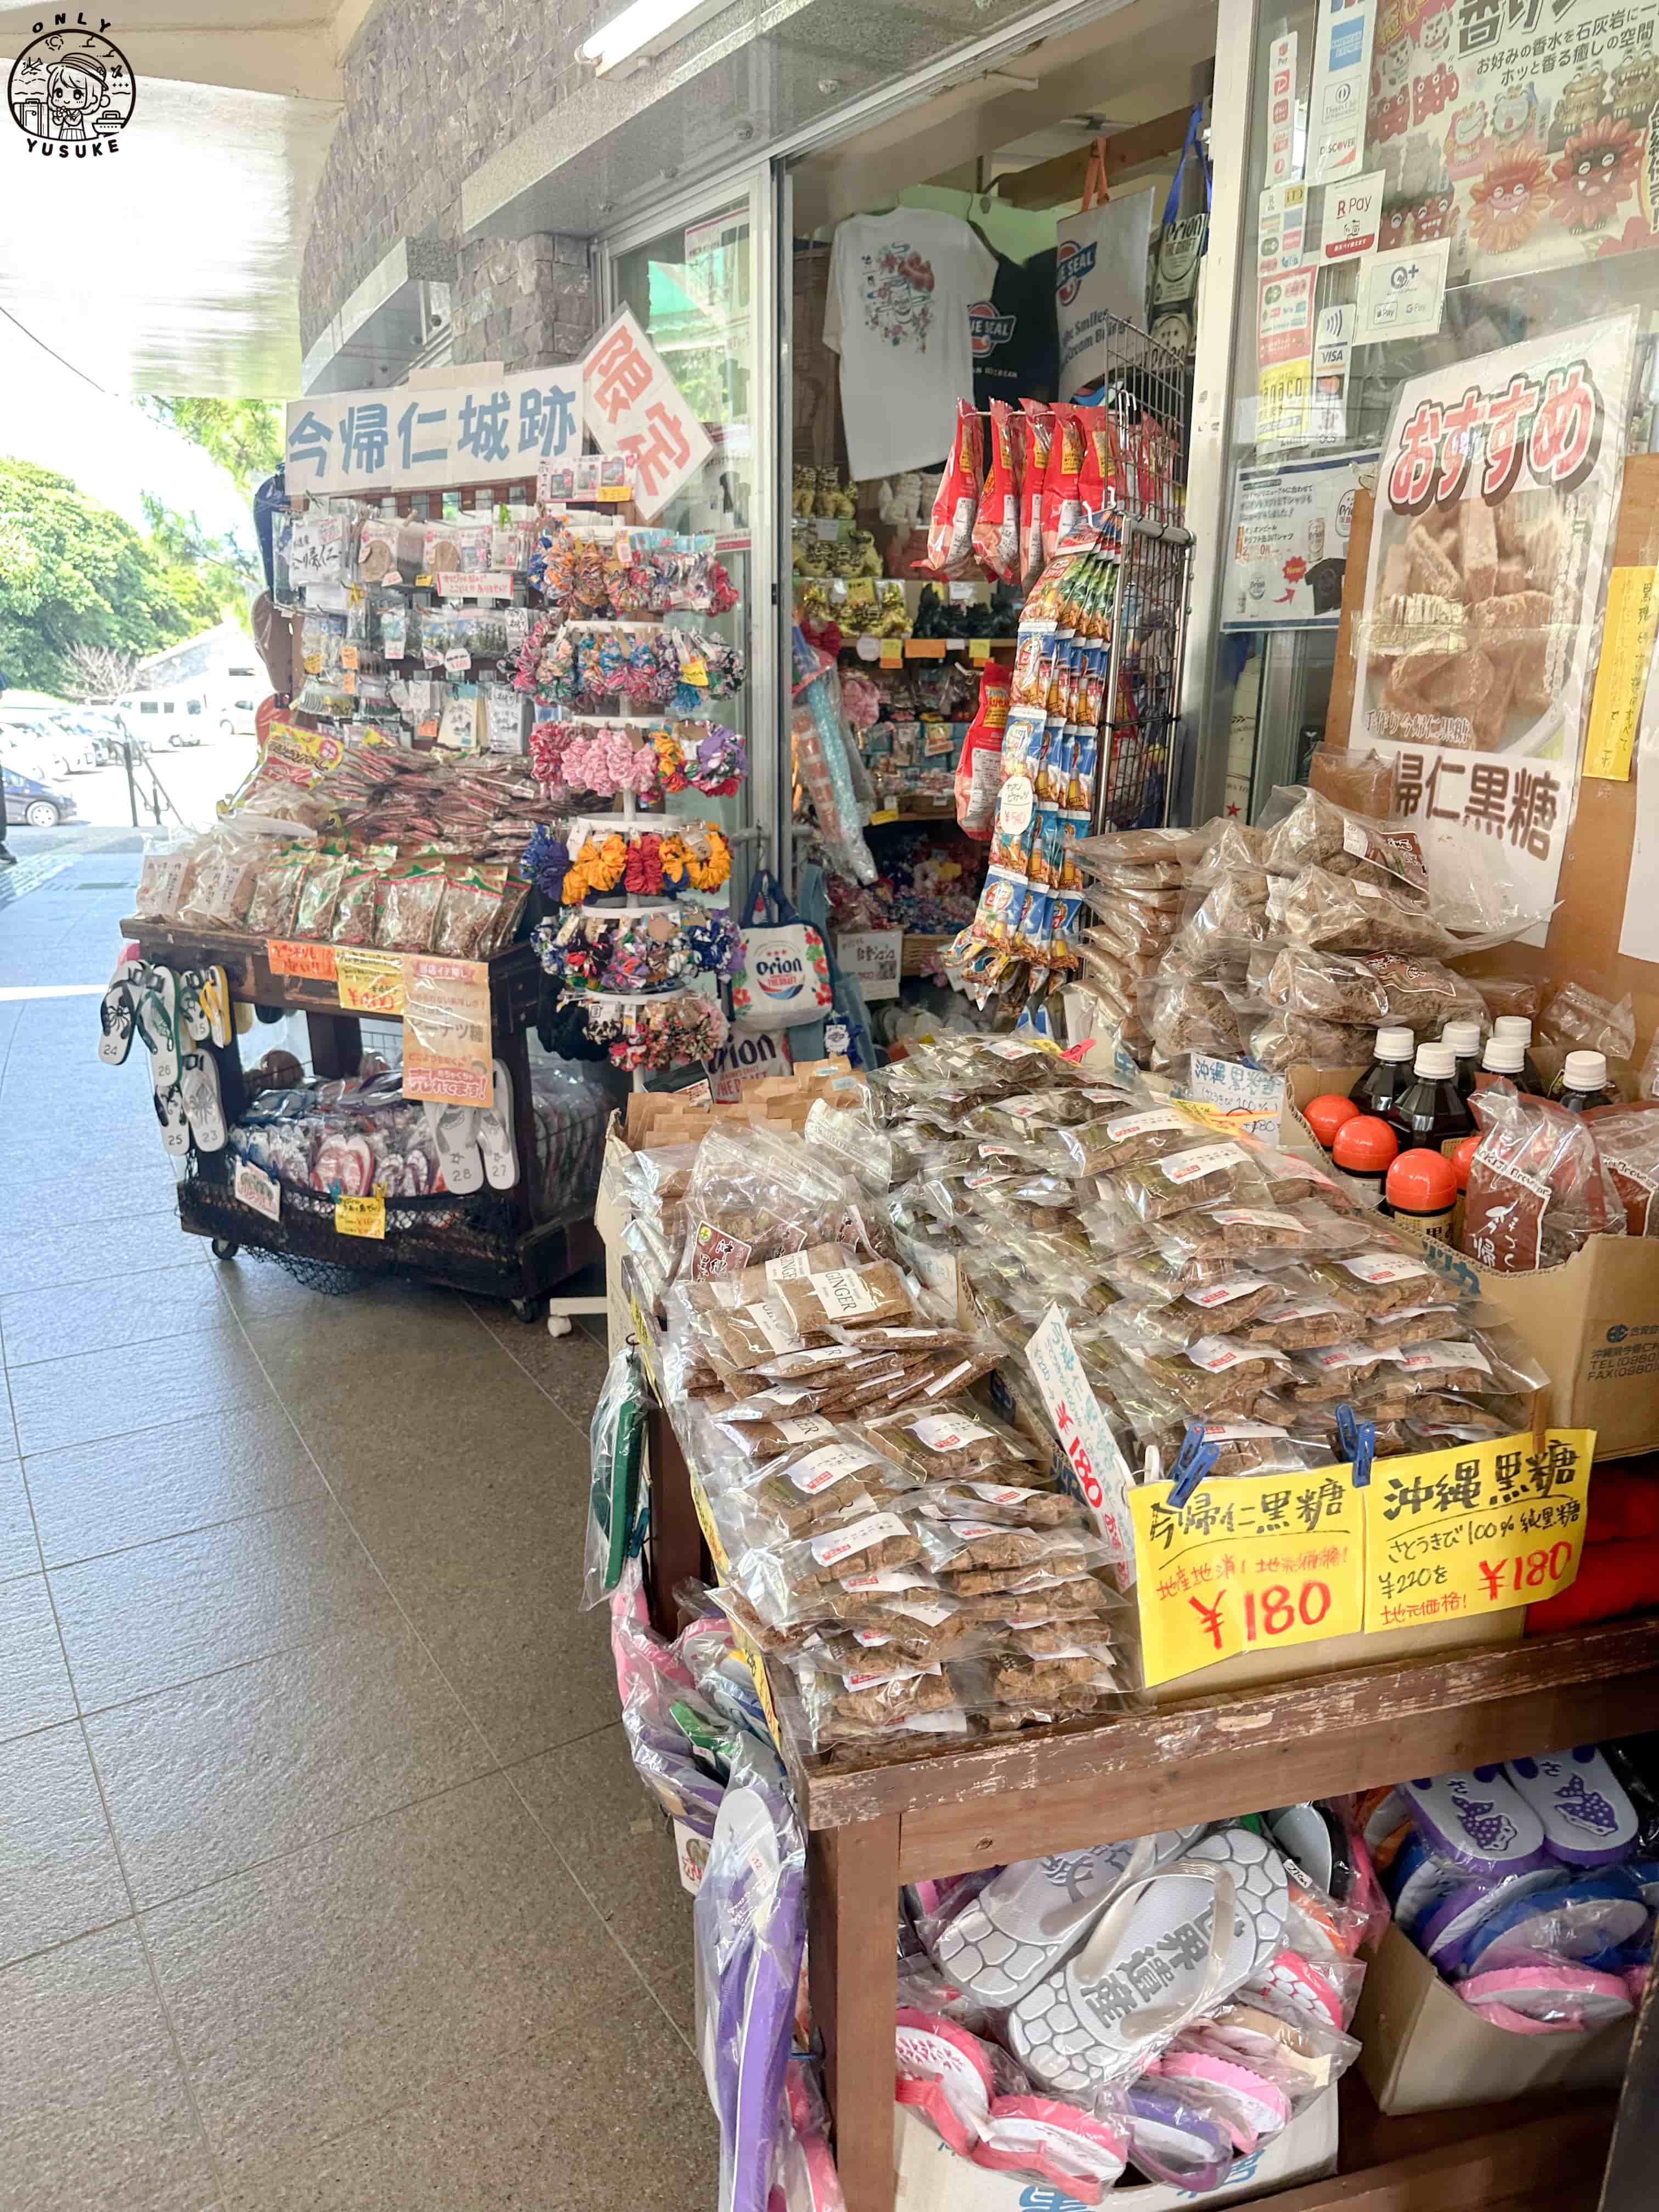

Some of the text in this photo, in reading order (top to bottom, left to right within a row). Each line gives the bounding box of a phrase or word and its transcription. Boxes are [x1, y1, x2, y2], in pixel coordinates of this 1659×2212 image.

[1476, 3, 1659, 75] お好みの香水を石灰岩に一
[1502, 20, 1655, 86] ホッと香る癒しの空間
[1349, 195, 1372, 213] Pay
[1322, 351, 1344, 364] VISA
[584, 325, 693, 498] 限定
[289, 385, 577, 477] 今帰仁城跡
[1390, 362, 1602, 511] おすすめ
[104, 1045, 117, 1056] 24
[157, 1065, 172, 1077] 26
[409, 1069, 487, 1101] 売れてます!
[167, 1134, 183, 1146] 25
[201, 1132, 218, 1142] 23
[453, 1169, 472, 1182] 28
[492, 1165, 507, 1177] 27
[825, 1271, 857, 1311] GINGER
[1587, 1364, 1659, 1381] FAX(0980
[1590, 1352, 1659, 1370] TEL(0980
[1054, 1400, 1103, 1509] ¥180
[1384, 1440, 1581, 1521] 沖縄黒糖
[1150, 1478, 1346, 1550] 今帰仁黒糖
[1520, 1499, 1581, 1534] 純黒糖
[1156, 1554, 1246, 1601] 地産地消!
[1379, 1565, 1448, 1600] ¥220を
[1477, 1540, 1572, 1601] ¥180
[1188, 1579, 1332, 1650] ¥180
[1380, 1591, 1467, 1626] 地元価格!
